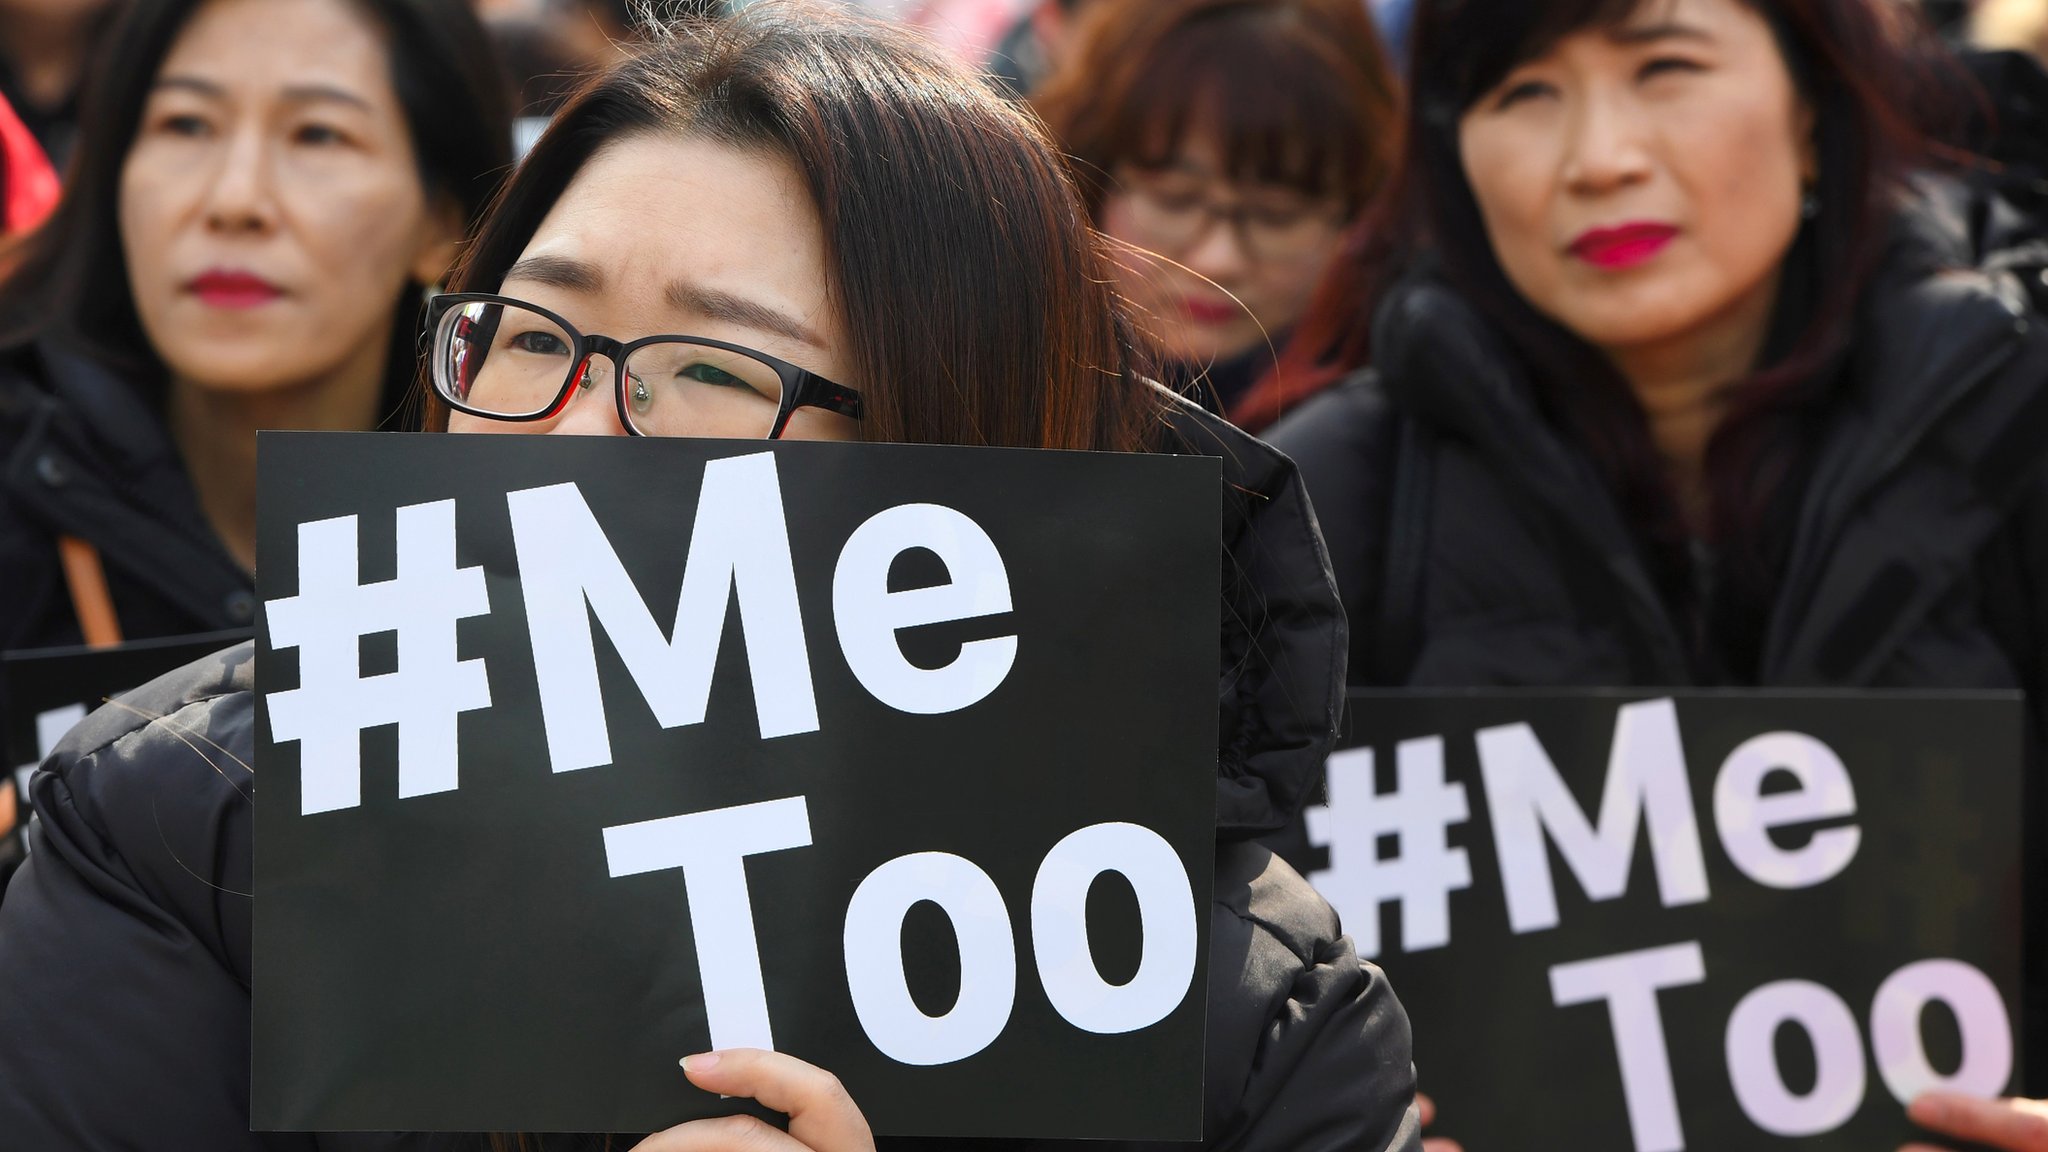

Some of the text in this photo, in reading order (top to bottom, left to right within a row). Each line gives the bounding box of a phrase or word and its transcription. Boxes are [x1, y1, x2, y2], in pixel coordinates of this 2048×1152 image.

[265, 451, 1018, 816] #Me
[602, 795, 1198, 1099] Too
[1305, 697, 1860, 960] #Me
[1549, 940, 2014, 1152] Too
